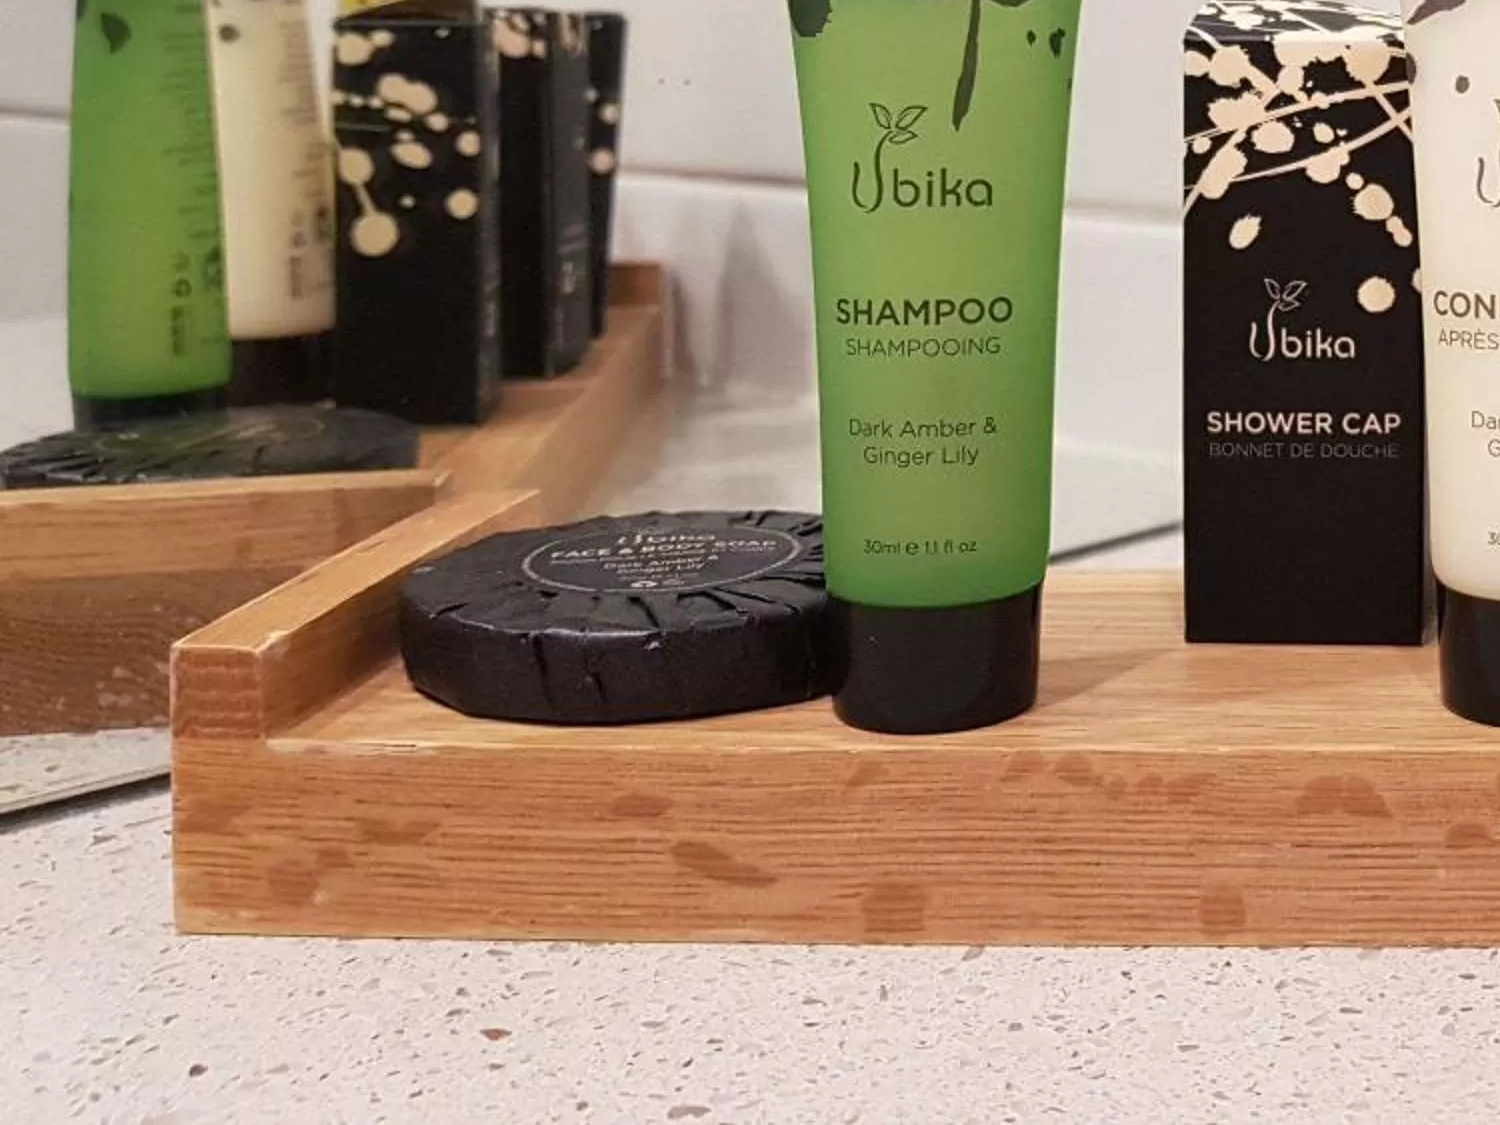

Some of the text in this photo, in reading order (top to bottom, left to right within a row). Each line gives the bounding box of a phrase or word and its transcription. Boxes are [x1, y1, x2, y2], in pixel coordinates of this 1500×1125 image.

[852, 130, 994, 214] Ubika
[836, 296, 1014, 326] SHAMPOO
[1249, 300, 1356, 362] Ubika
[1437, 327, 1500, 351] APRÈS
[846, 336, 1002, 358] SHAMPOOING
[849, 416, 997, 438] Dark Amber &
[1207, 410, 1402, 435] SHOWER CAP
[863, 446, 980, 469] Ginger Lily
[1208, 442, 1400, 458] BONNET DE DOUCHE
[863, 539, 901, 555] 30ml
[959, 540, 977, 554] oz
